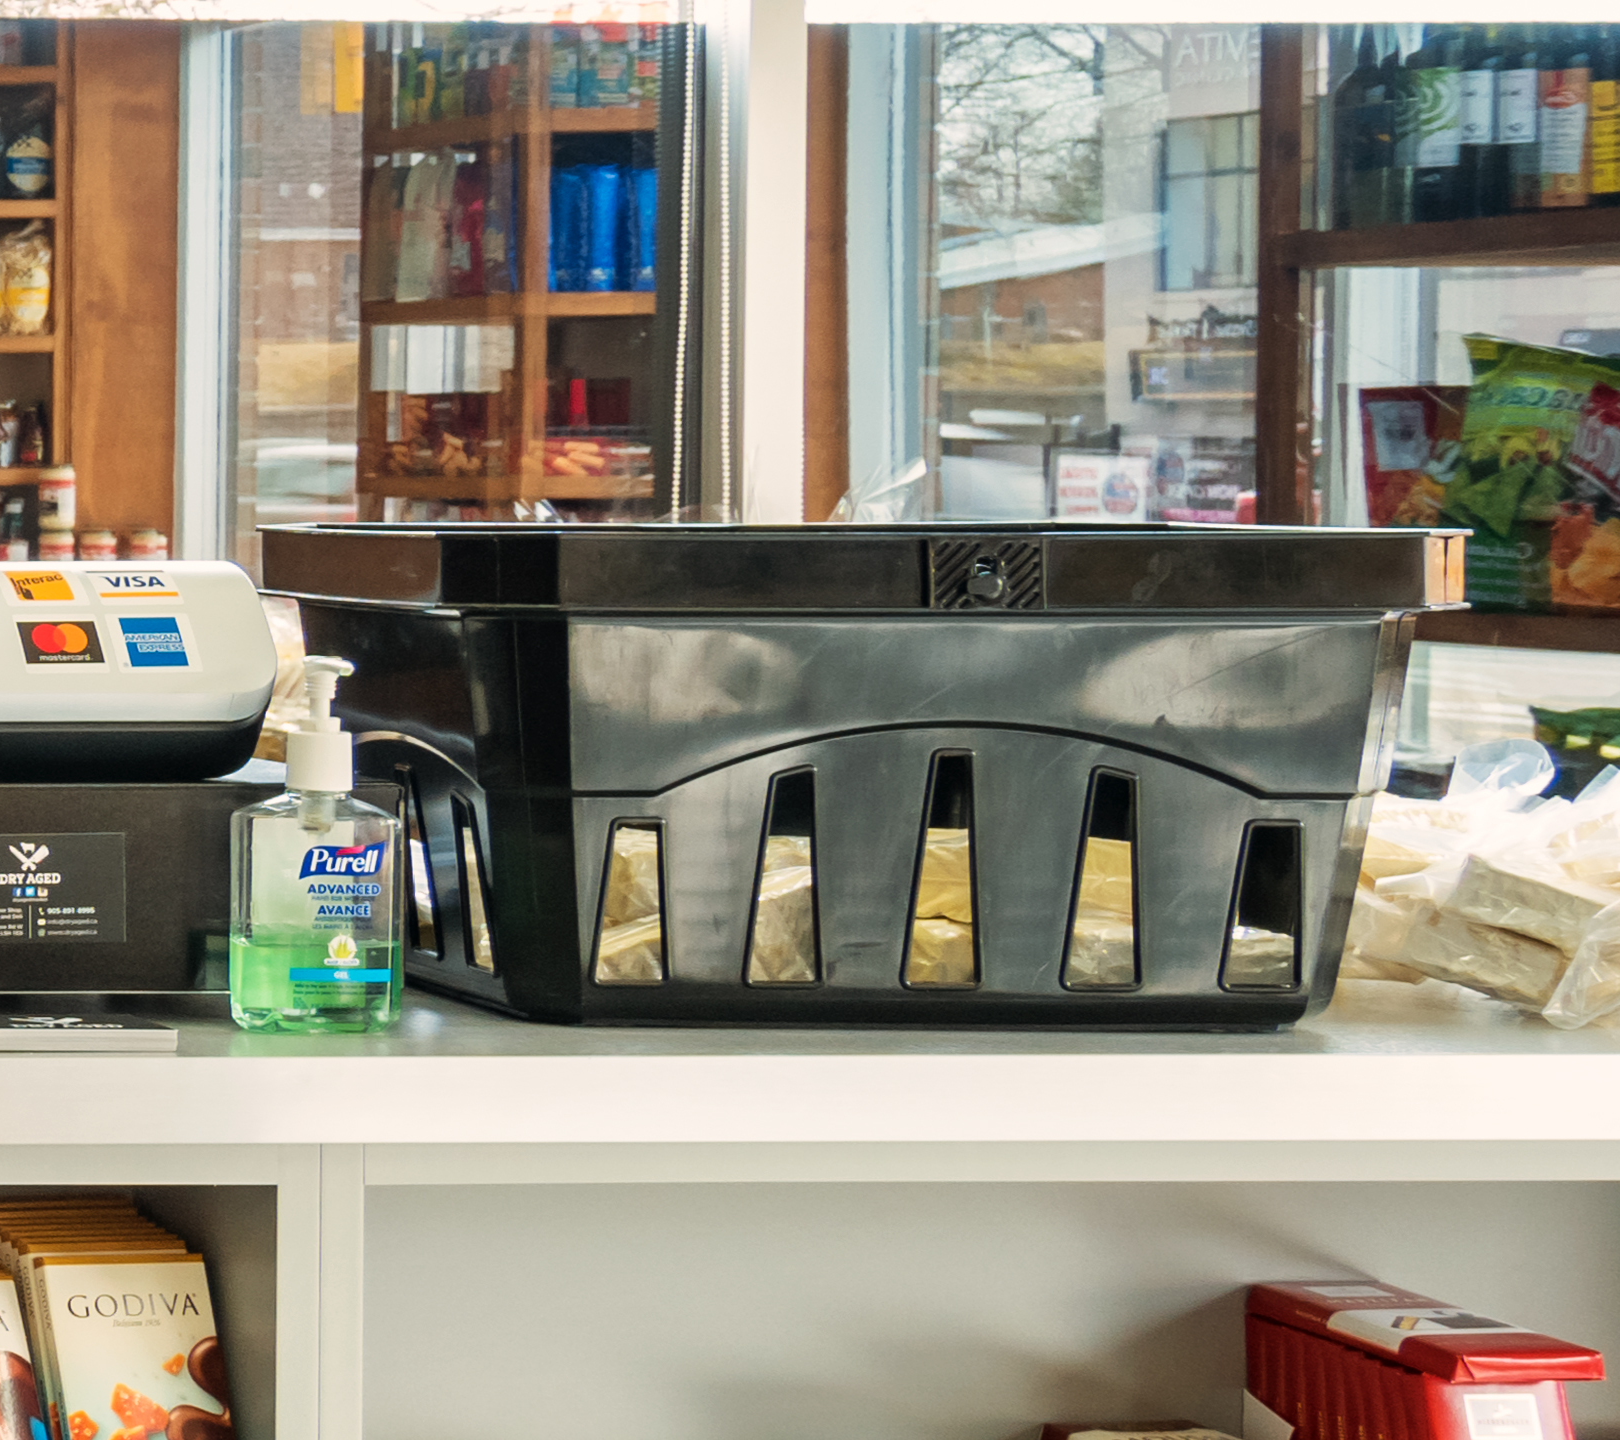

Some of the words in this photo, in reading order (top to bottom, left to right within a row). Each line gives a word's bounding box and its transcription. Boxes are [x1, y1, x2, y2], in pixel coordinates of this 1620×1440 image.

[106, 575, 165, 589] VISA
[124, 633, 180, 642] AMERICAN
[138, 642, 185, 652] EXPRESS
[310, 848, 378, 872] Purell
[0, 873, 25, 884] DRY
[26, 873, 61, 884] AGED
[308, 884, 380, 894] ADVANCED
[318, 901, 370, 915] AVANCÉ
[67, 1293, 197, 1319] GODIVA
